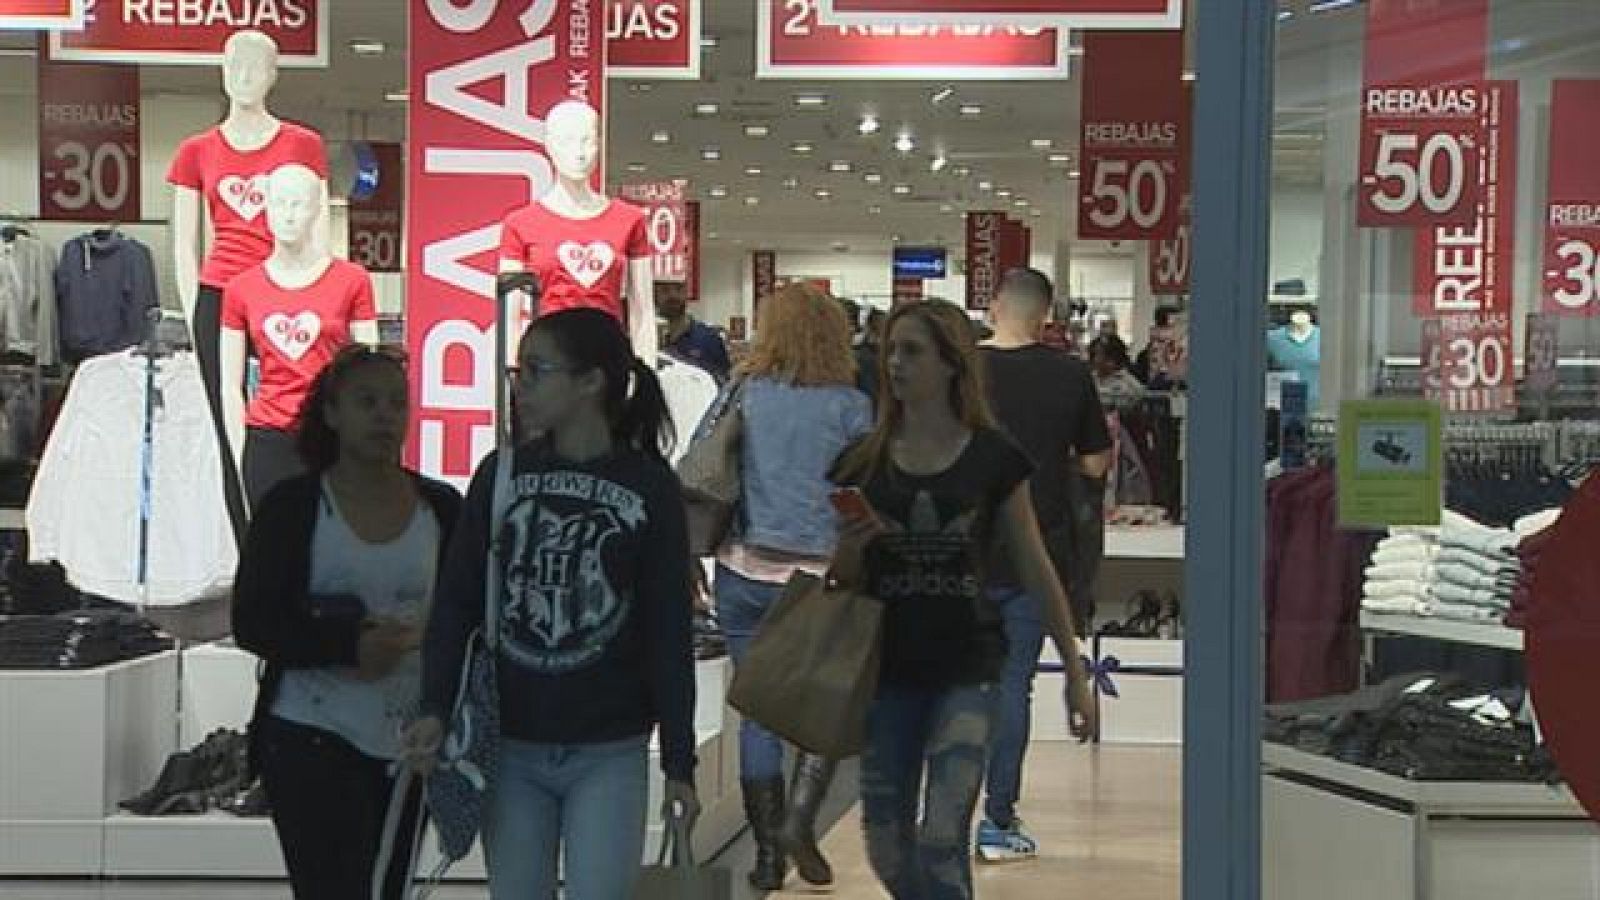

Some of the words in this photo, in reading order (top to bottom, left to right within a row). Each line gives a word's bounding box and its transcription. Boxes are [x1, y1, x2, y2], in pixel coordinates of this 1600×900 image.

[121, 0, 307, 27] REBAJAS
[43, 103, 137, 124] REBAJAS
[1367, 89, 1476, 114] REBAJAS
[1085, 123, 1177, 142] REBAJAS
[1546, 240, 1600, 307] -3
